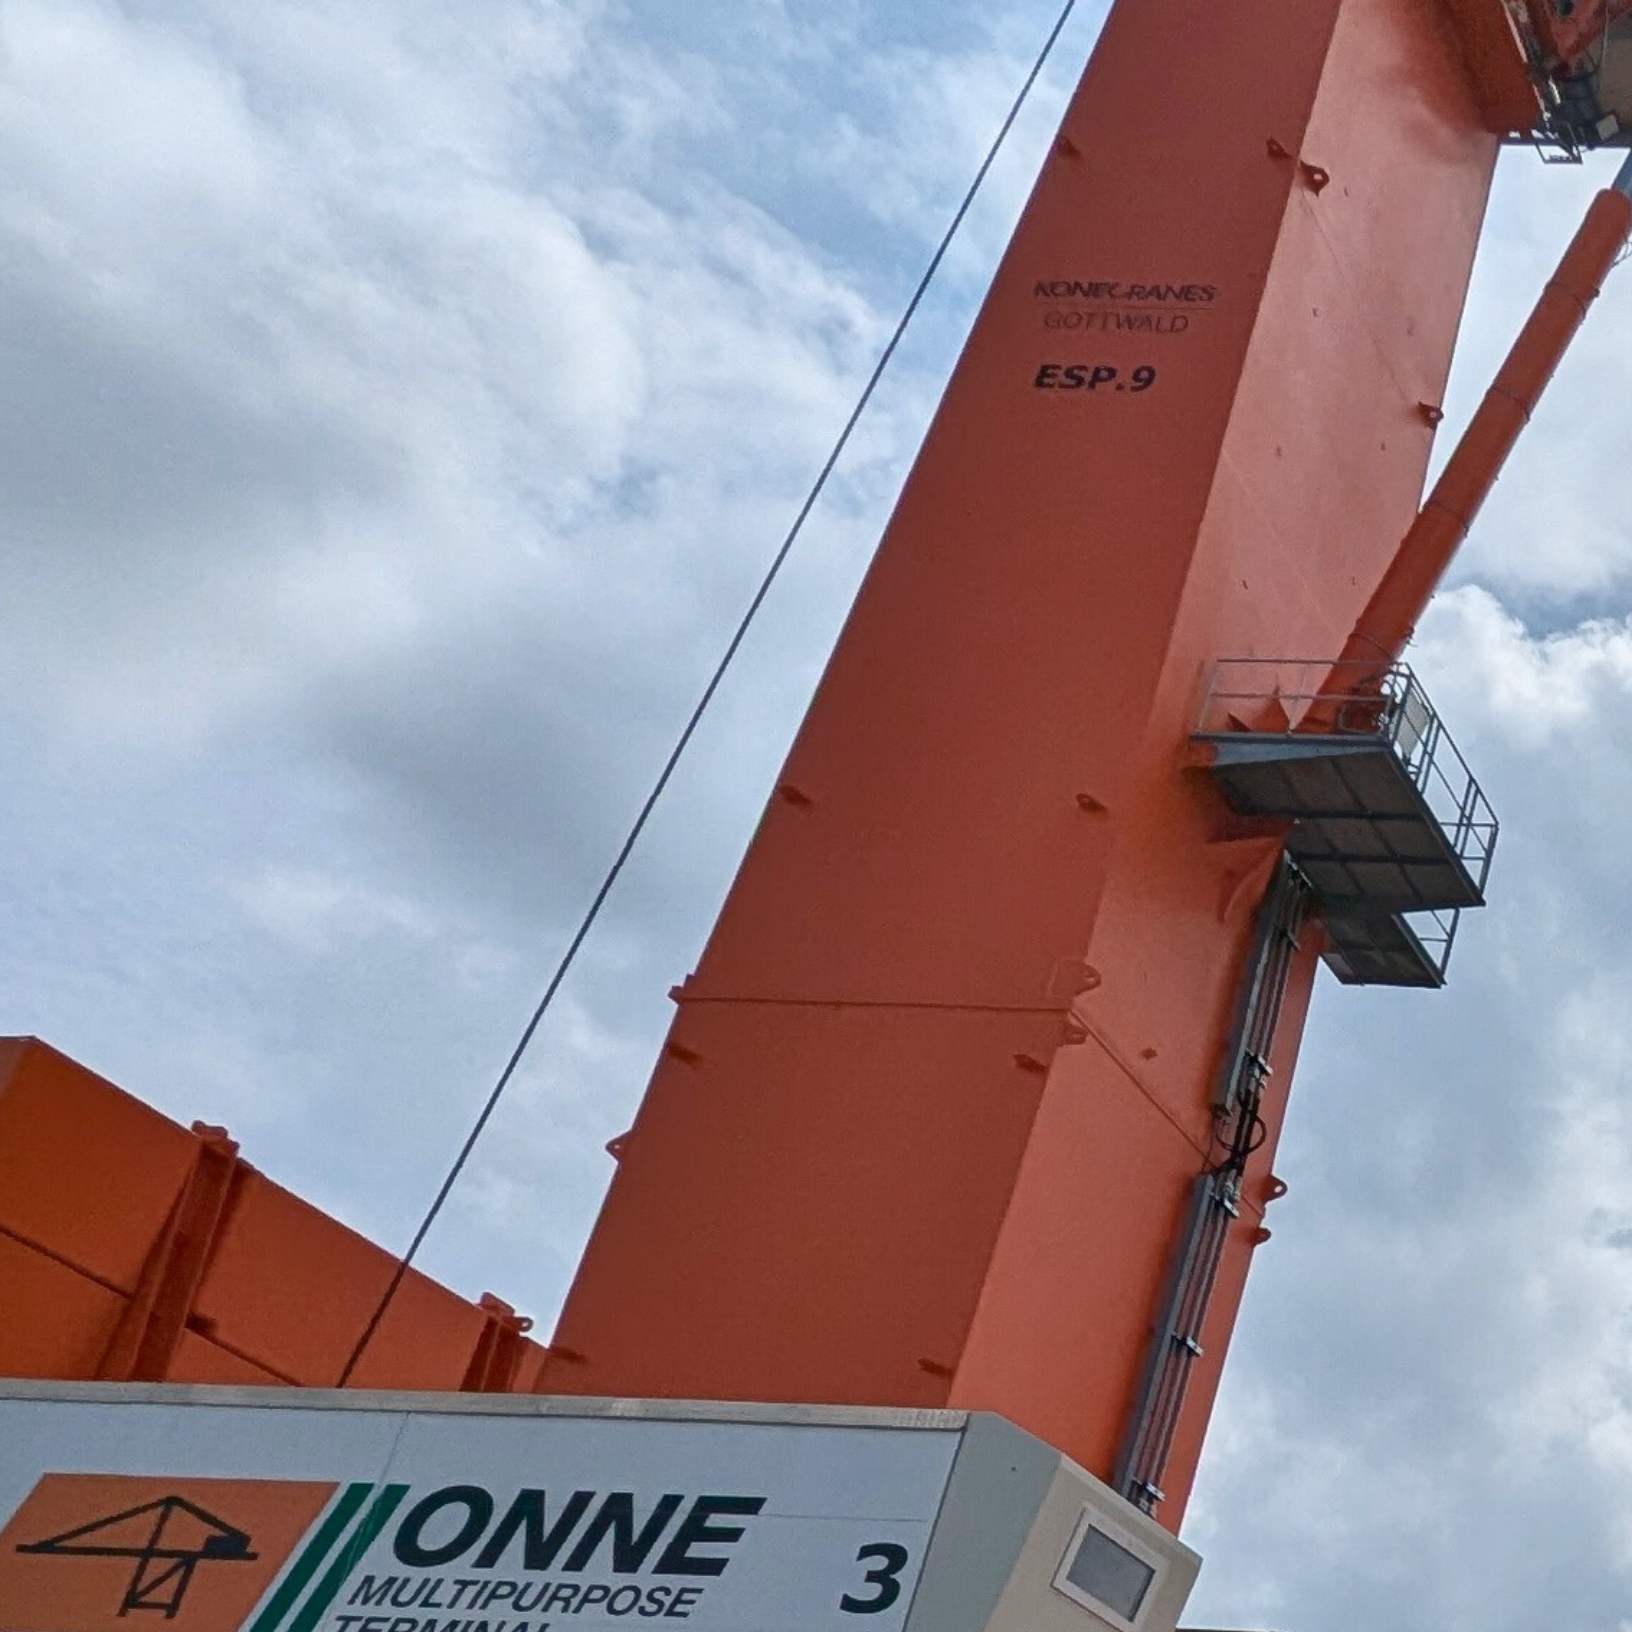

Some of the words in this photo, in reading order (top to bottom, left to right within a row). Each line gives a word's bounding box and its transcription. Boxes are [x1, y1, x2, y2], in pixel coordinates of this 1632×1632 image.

[1032, 280, 1217, 302] KONECRANES
[1044, 311, 1189, 333] GOTTWALD
[1034, 363, 1157, 392] ESP.9
[393, 1484, 767, 1577] ONNE
[838, 1542, 909, 1614] 3
[347, 1575, 704, 1619] MULTIPURPOSE
